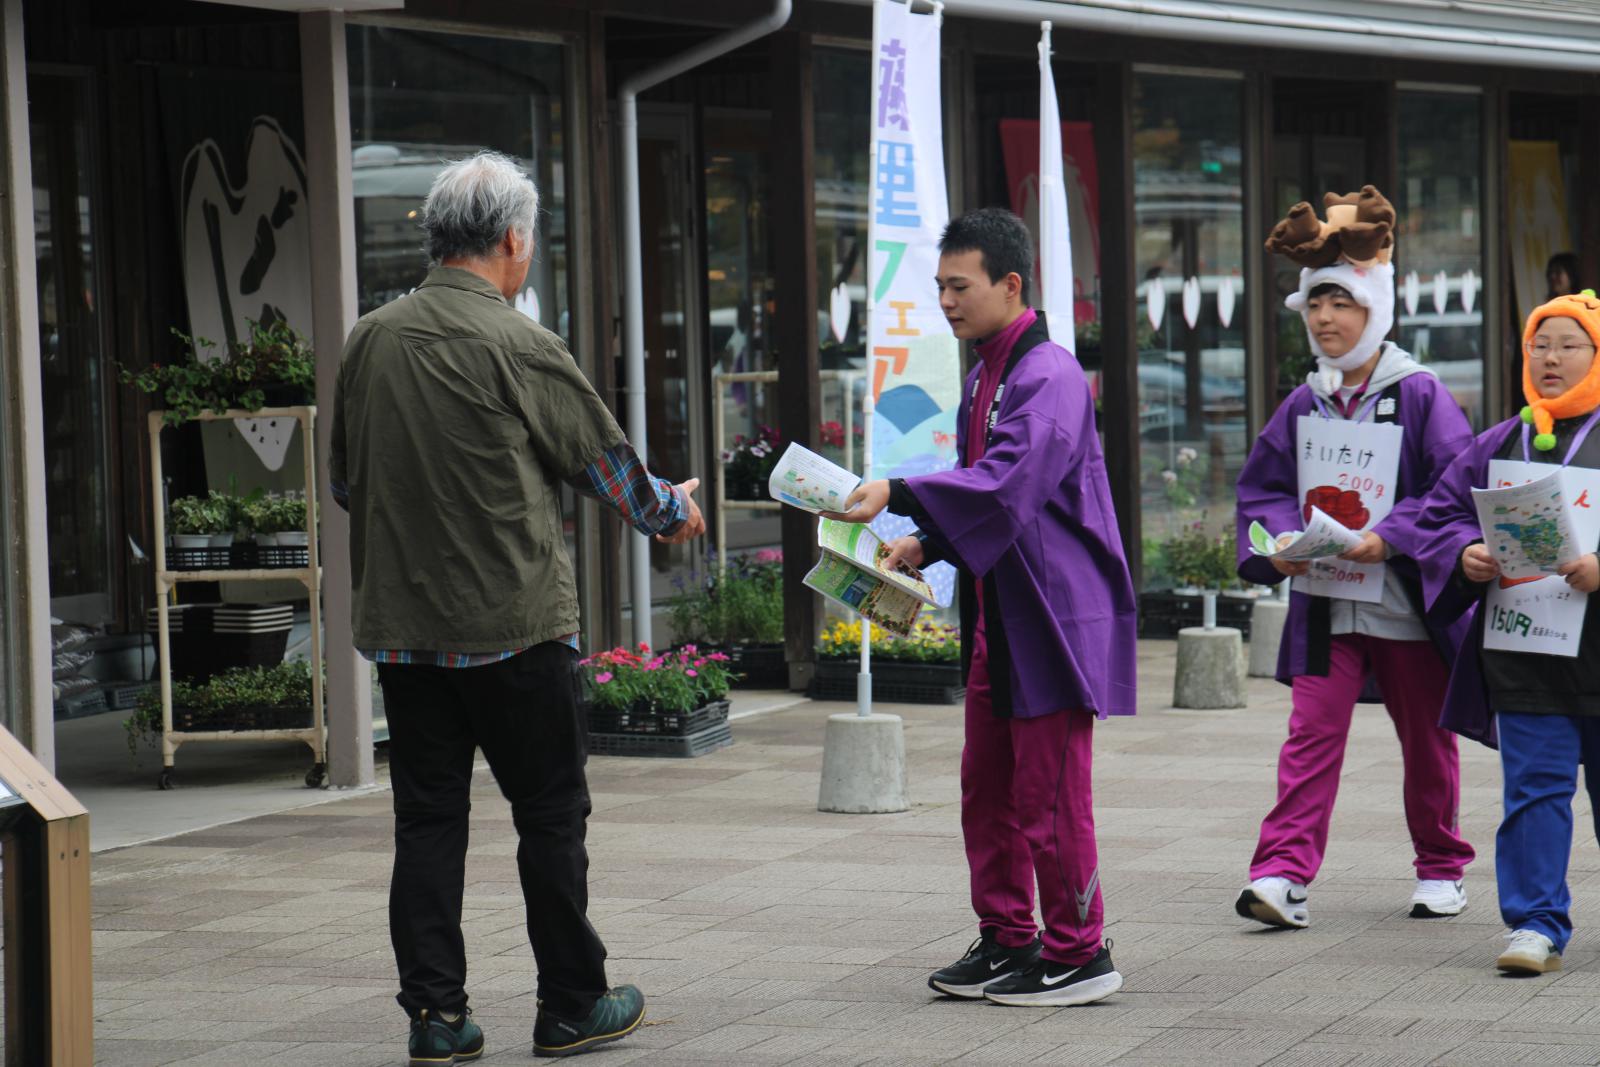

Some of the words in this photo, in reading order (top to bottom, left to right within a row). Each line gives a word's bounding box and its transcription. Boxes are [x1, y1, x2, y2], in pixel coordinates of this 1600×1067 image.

[1303, 436, 1375, 469] まいたけ
[1337, 473, 1385, 499] 200g
[1490, 604, 1533, 637] 150円
